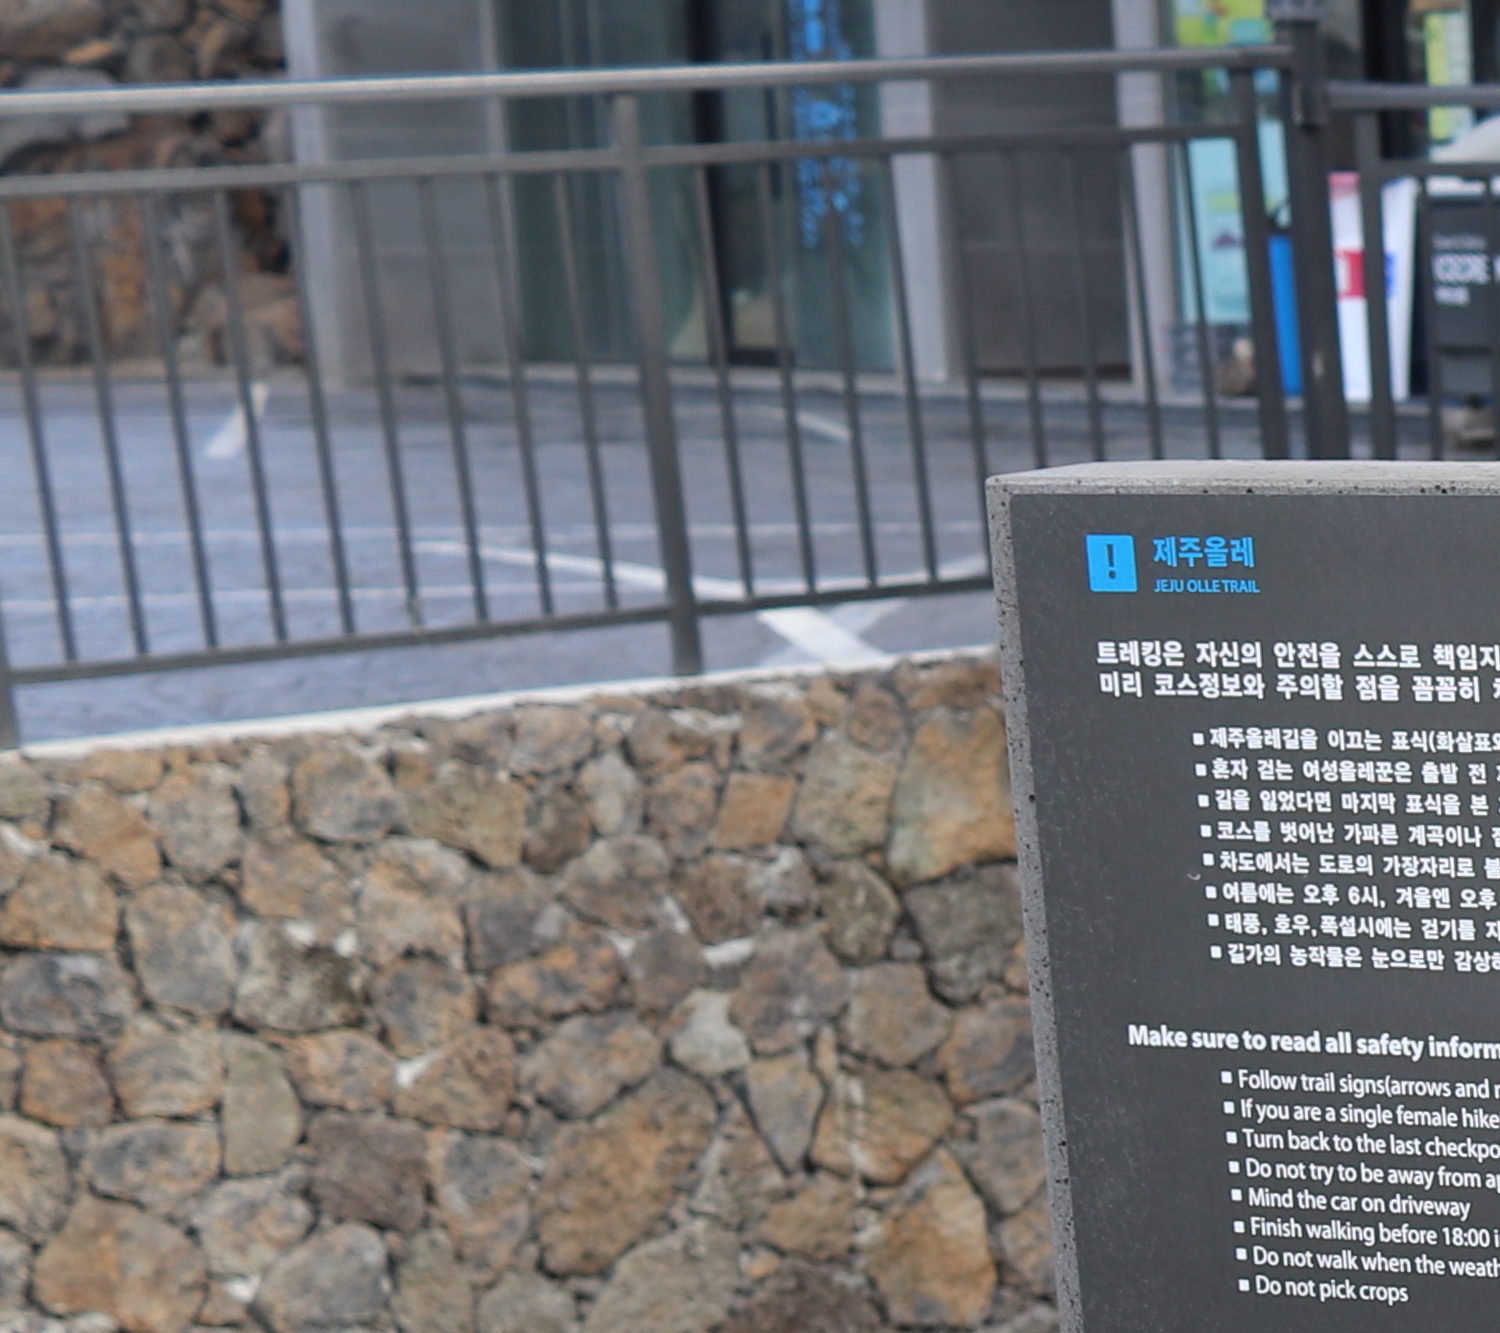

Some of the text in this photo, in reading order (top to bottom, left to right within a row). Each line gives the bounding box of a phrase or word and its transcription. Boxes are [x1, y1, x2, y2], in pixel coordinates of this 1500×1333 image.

[1153, 535, 1255, 568] 제주올레
[1097, 640, 1185, 667] 트레킹은
[1196, 641, 1262, 668] 자신의
[1273, 641, 1341, 669] 안전을
[1353, 644, 1421, 668] 스스로
[1099, 671, 1142, 698] 미리
[1154, 672, 1265, 700] 코스정보와
[1276, 673, 1344, 700] 주의할
[1355, 674, 1400, 701] 점을
[1411, 675, 1480, 703] 꼼꼼히
[1128, 1024, 1188, 1048] Make
[1191, 1031, 1239, 1050] sure
[1242, 1030, 1267, 1051] to
[1270, 1030, 1321, 1053] read
[1325, 1031, 1352, 1054] all
[1356, 1032, 1424, 1062] safety
[1250, 1216, 1303, 1238] Finish
[1305, 1219, 1375, 1247] walking
[1378, 1222, 1438, 1245] before
[1442, 1227, 1490, 1248] 18:00
